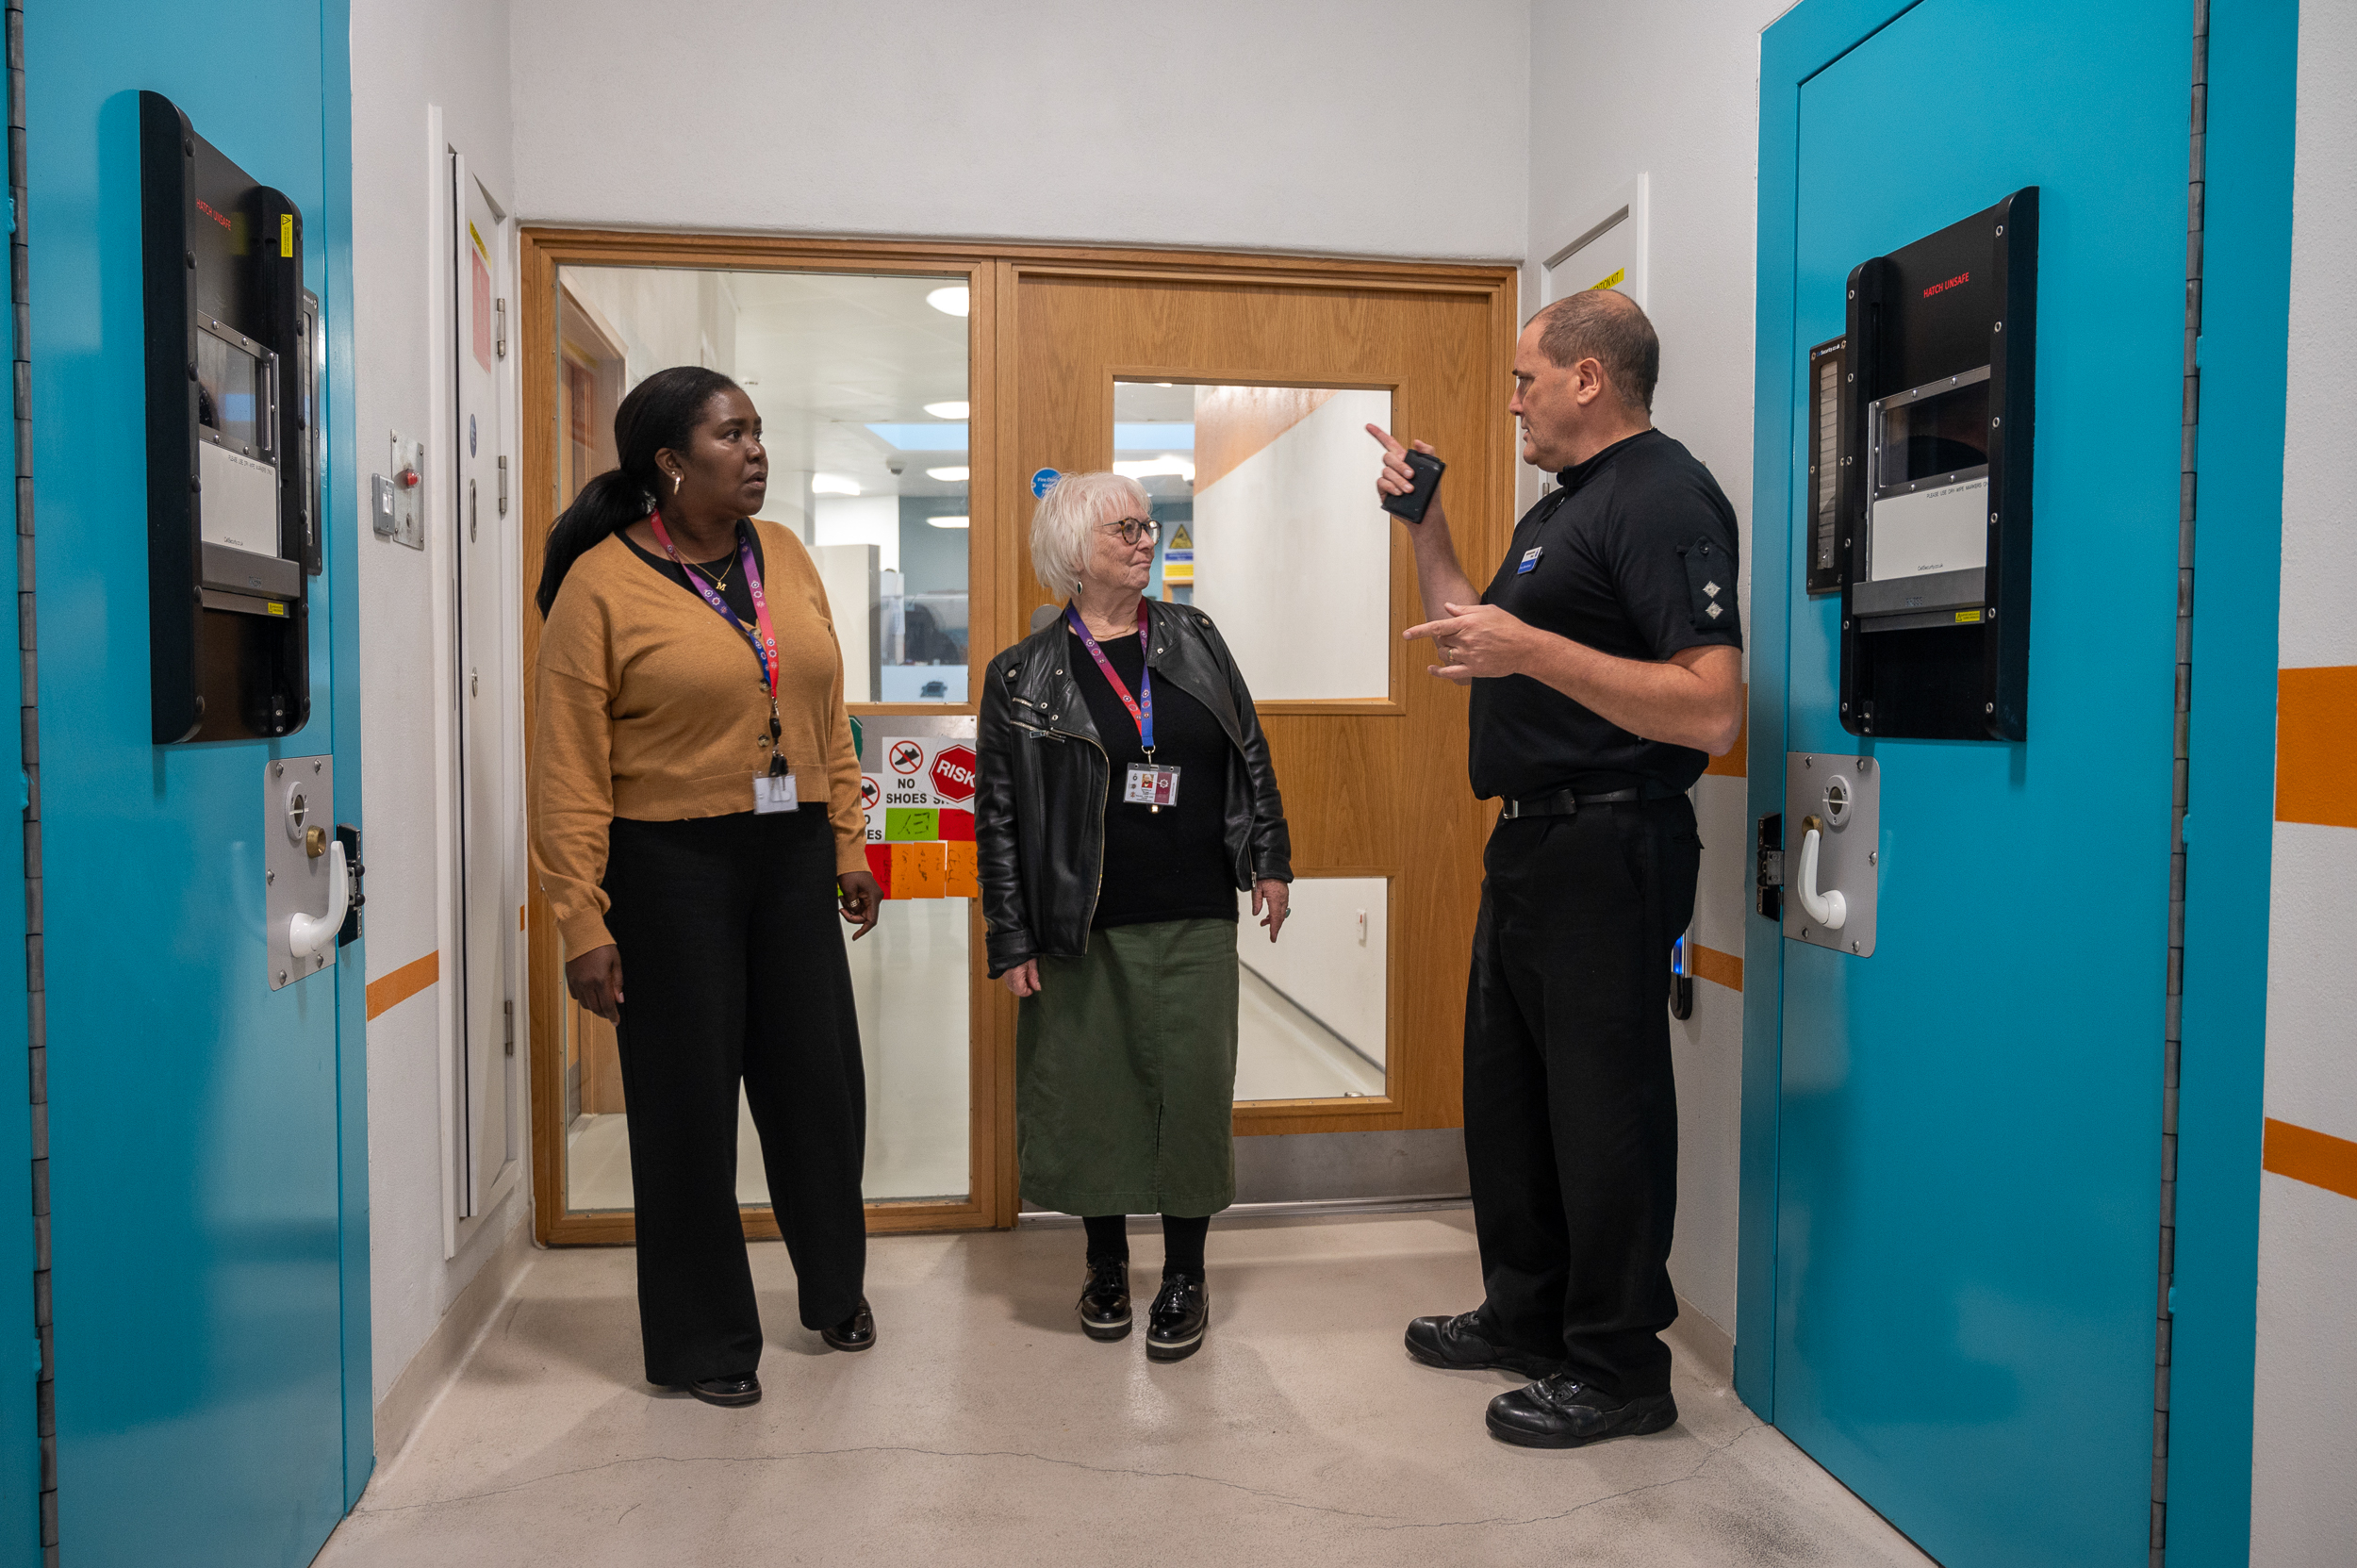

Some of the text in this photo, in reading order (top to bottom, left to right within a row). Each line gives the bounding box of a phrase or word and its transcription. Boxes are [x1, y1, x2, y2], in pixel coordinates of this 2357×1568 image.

[196, 198, 231, 231] HATCH UNSAFE
[1611, 272, 1620, 286] KIT
[1923, 272, 1970, 299] HATCH UNSAFE
[898, 778, 915, 789] NO
[937, 759, 976, 788] RISK
[886, 793, 928, 804] SHOES
